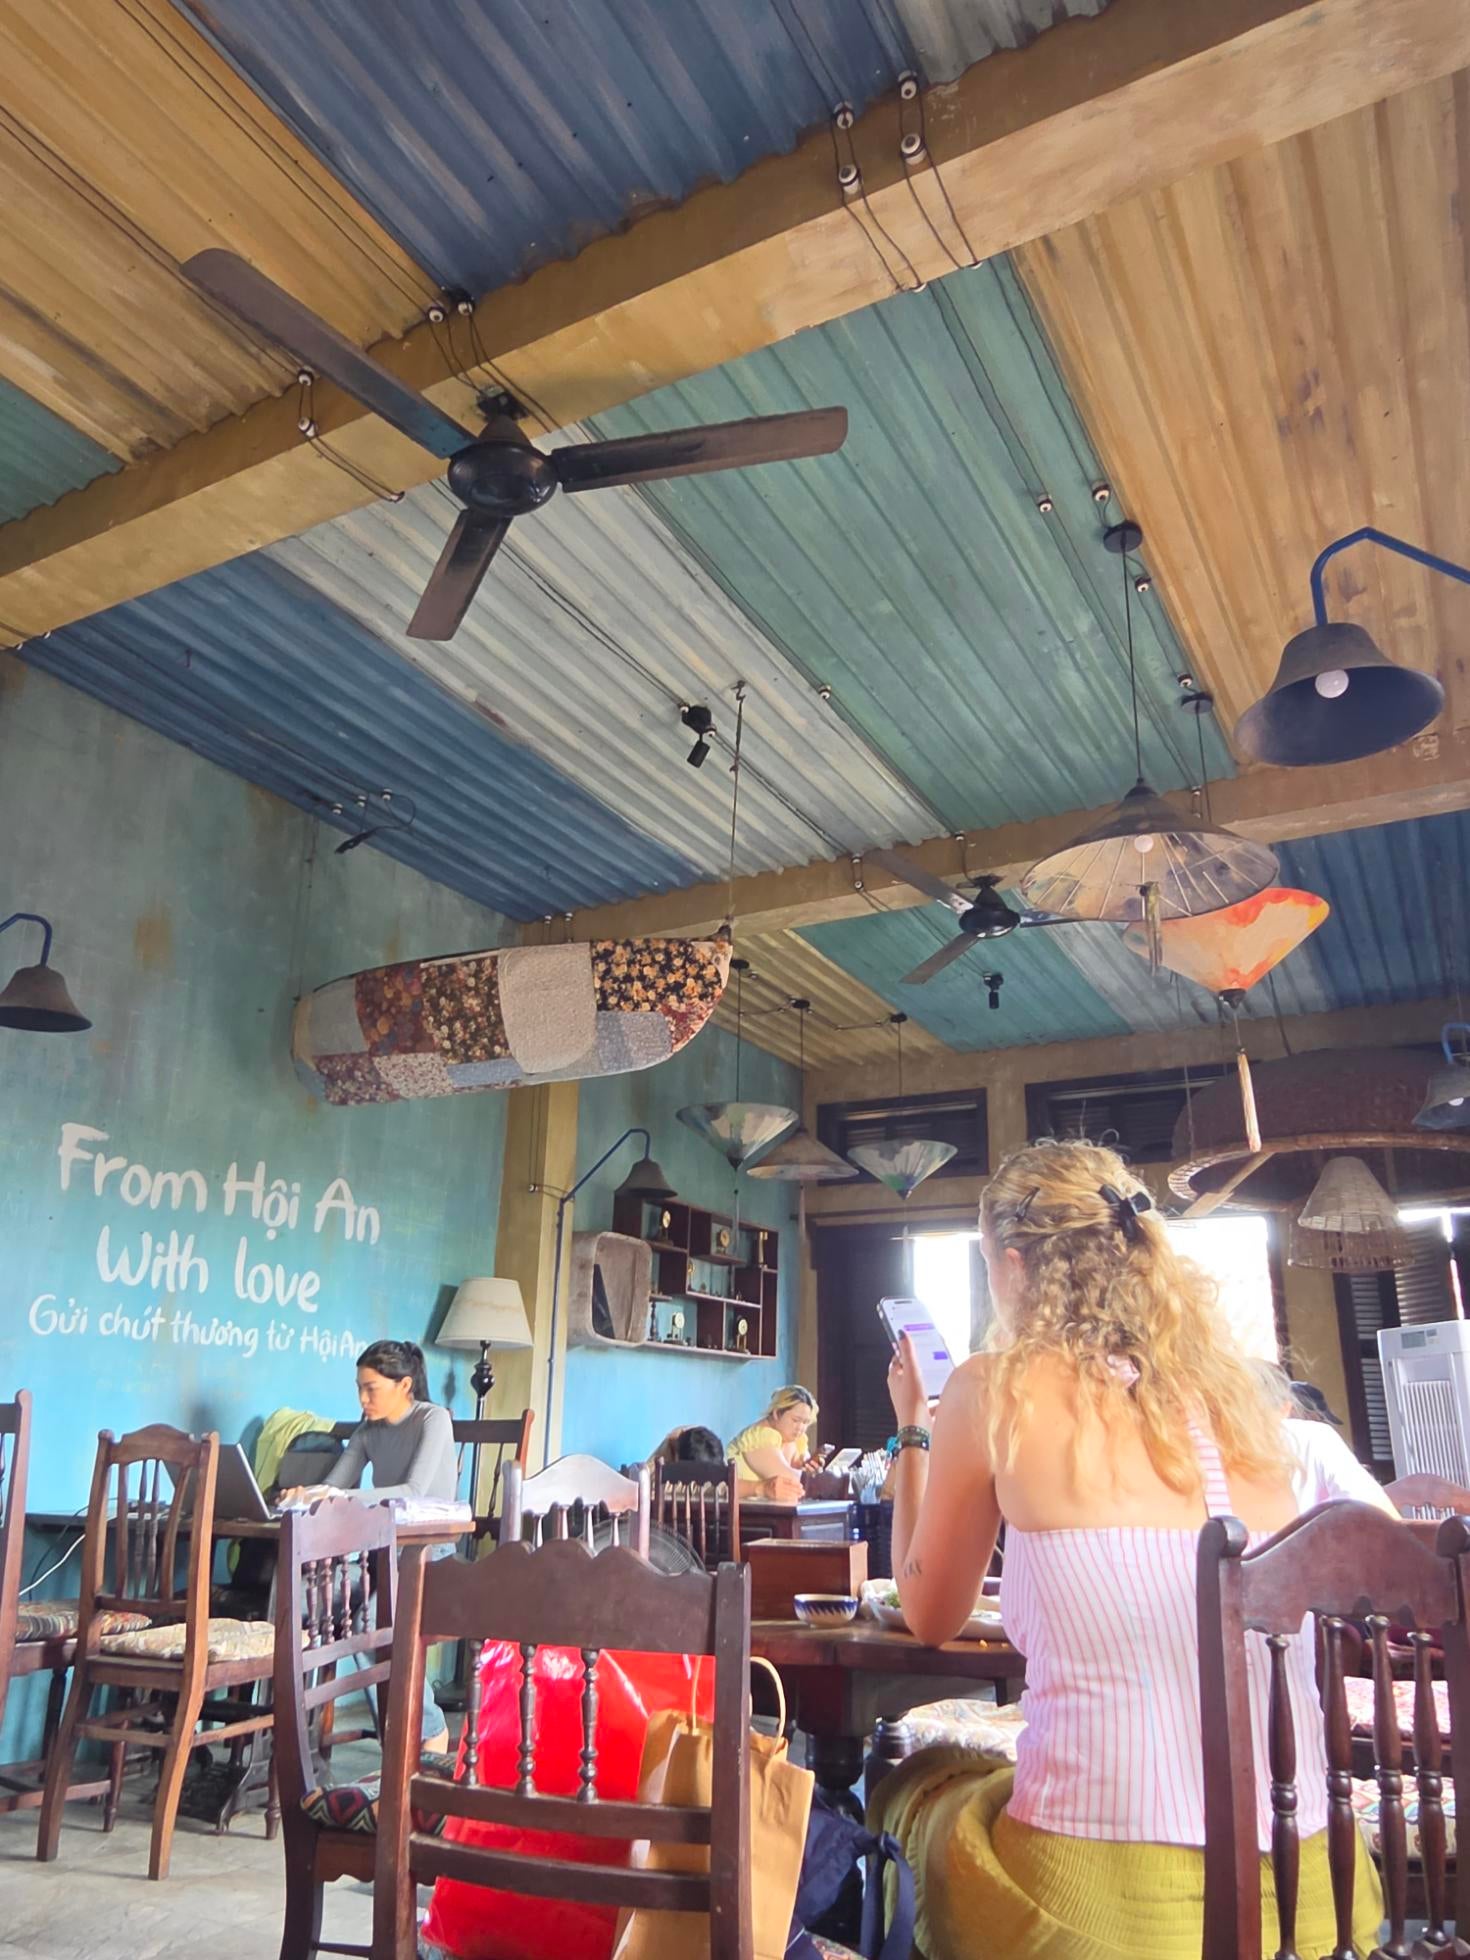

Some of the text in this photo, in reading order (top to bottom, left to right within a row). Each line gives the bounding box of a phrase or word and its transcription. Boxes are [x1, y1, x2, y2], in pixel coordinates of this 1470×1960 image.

[58, 1121, 381, 1245] From Hội An
[96, 1225, 321, 1313] With love
[28, 1293, 89, 1336] Gửi
[99, 1302, 166, 1342] chút
[266, 1319, 296, 1351] từ
